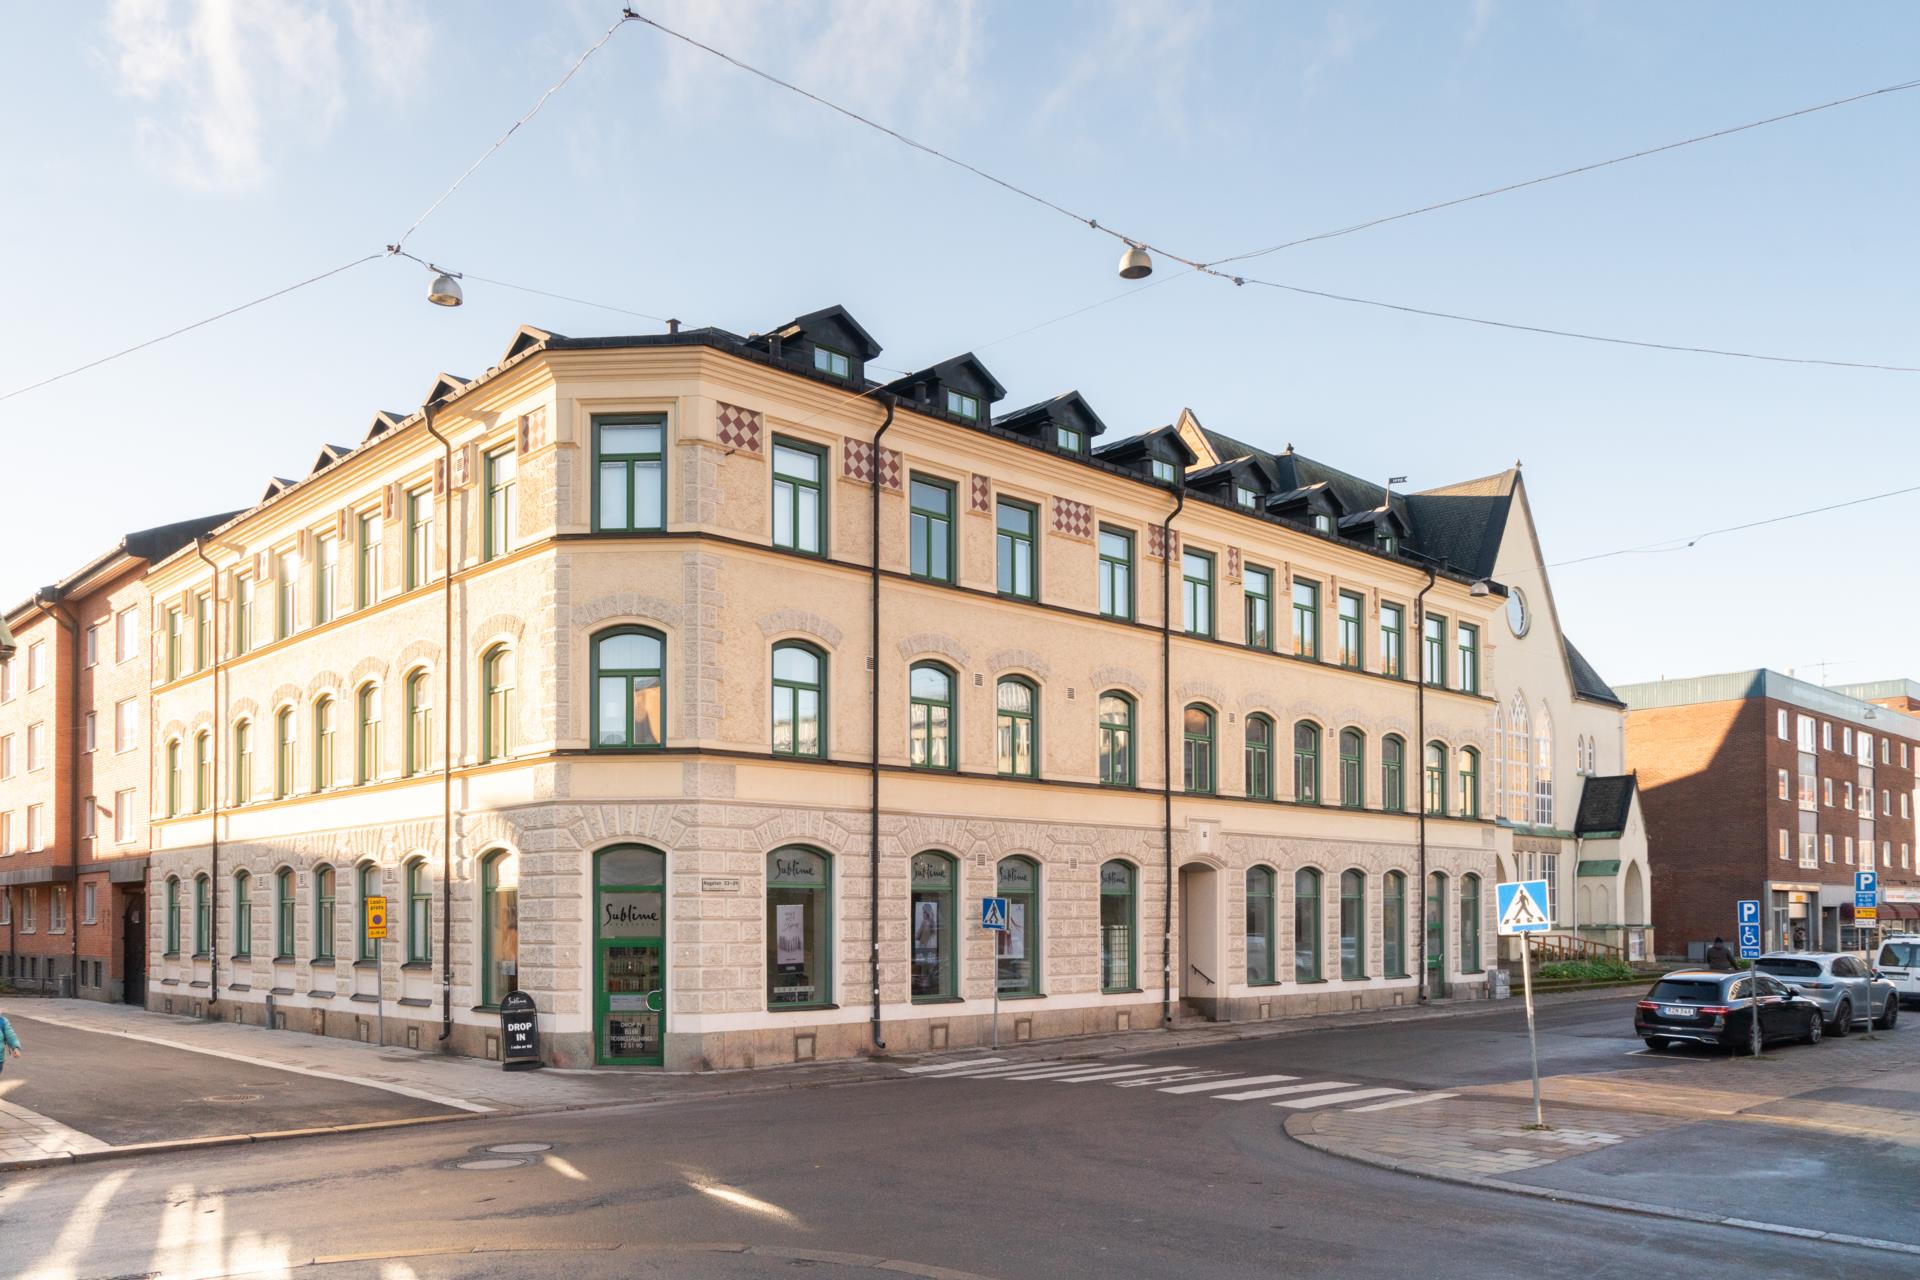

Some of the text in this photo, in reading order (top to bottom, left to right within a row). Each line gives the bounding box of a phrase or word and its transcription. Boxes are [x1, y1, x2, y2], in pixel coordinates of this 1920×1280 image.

[775, 859, 815, 880] Sublime
[1860, 874, 1873, 890] P
[603, 903, 660, 927] Sublime
[1743, 903, 1756, 922] P
[507, 1022, 532, 1031] DROP
[516, 1033, 526, 1041] IN
